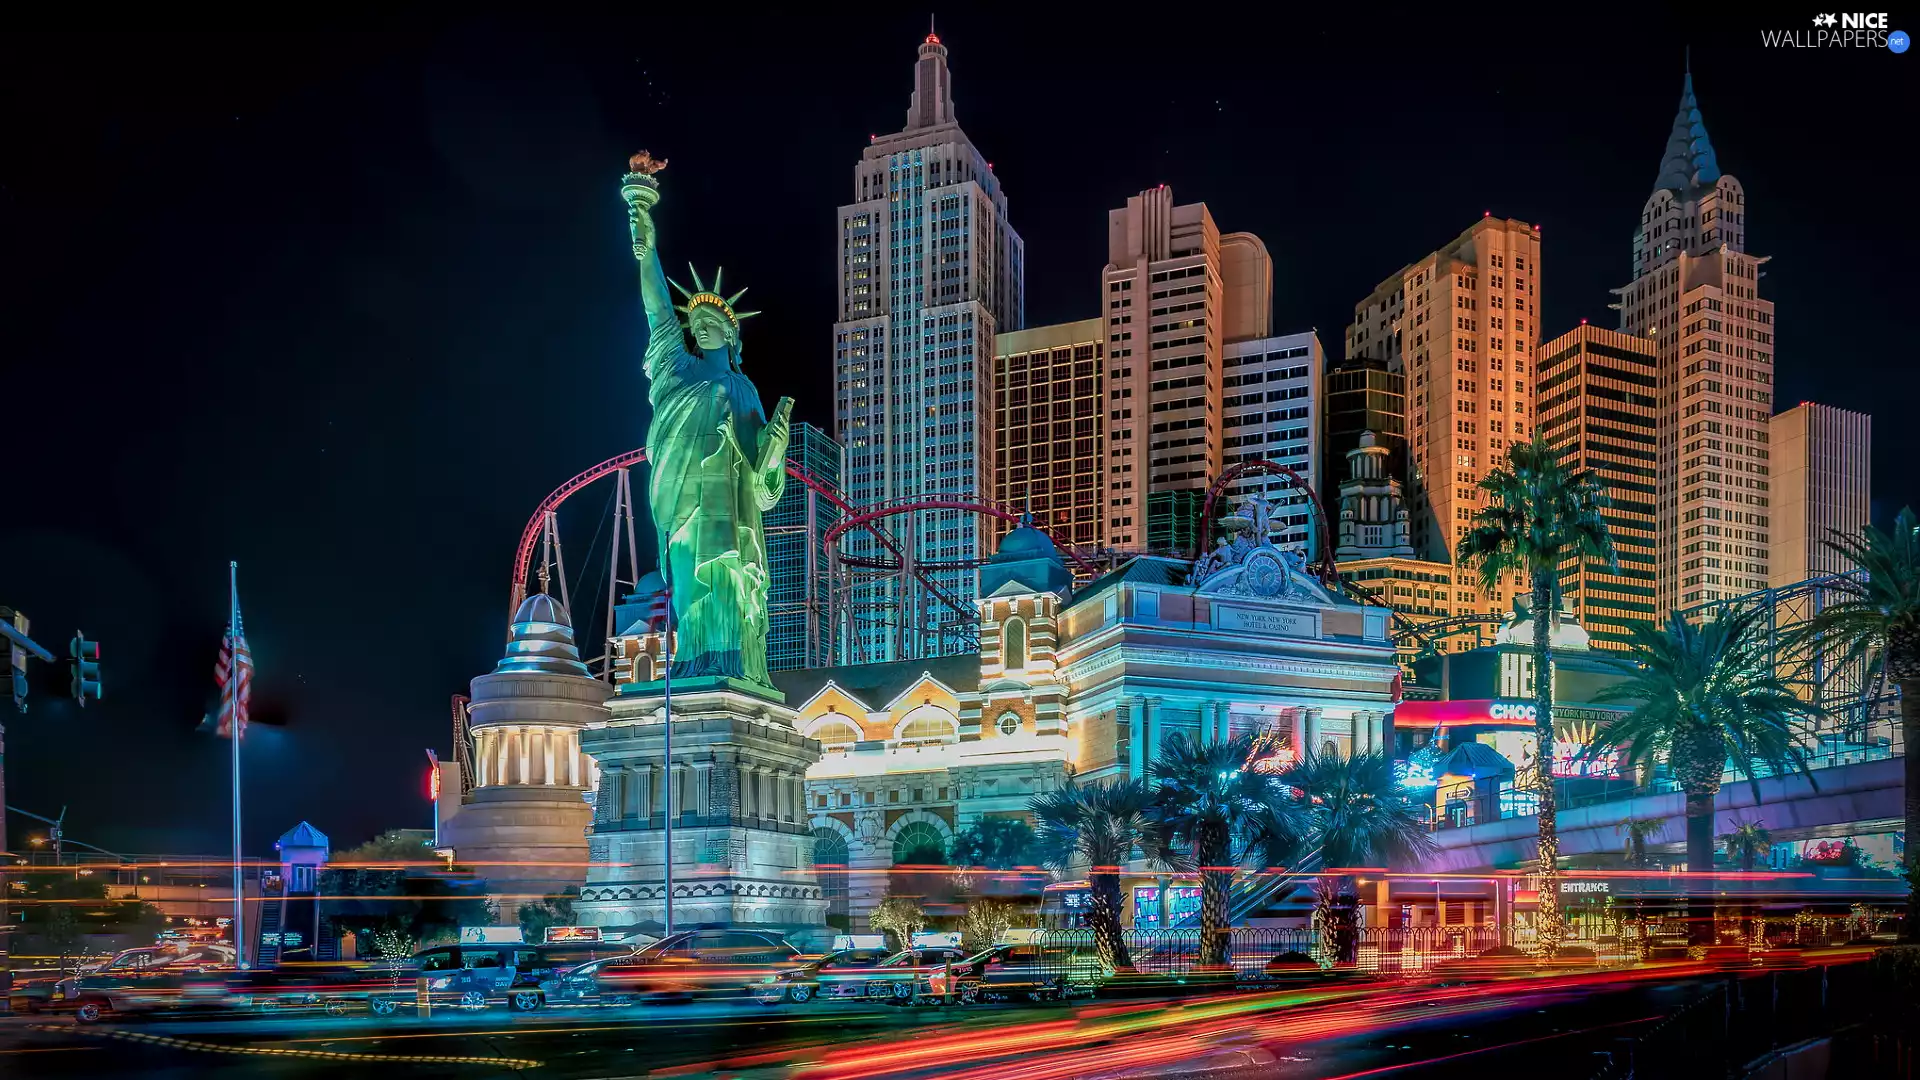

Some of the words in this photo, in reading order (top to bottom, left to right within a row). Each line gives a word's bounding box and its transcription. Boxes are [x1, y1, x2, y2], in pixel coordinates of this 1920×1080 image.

[1236, 612, 1249, 620] NEW
[1251, 614, 1266, 622] YORK
[1268, 615, 1280, 623] NEW
[1282, 616, 1297, 625] YORK
[1244, 621, 1262, 629] HOTEL
[1268, 623, 1289, 631] CASINO
[1501, 653, 1536, 698] HE
[1560, 882, 1610, 893] ENTRANCE
